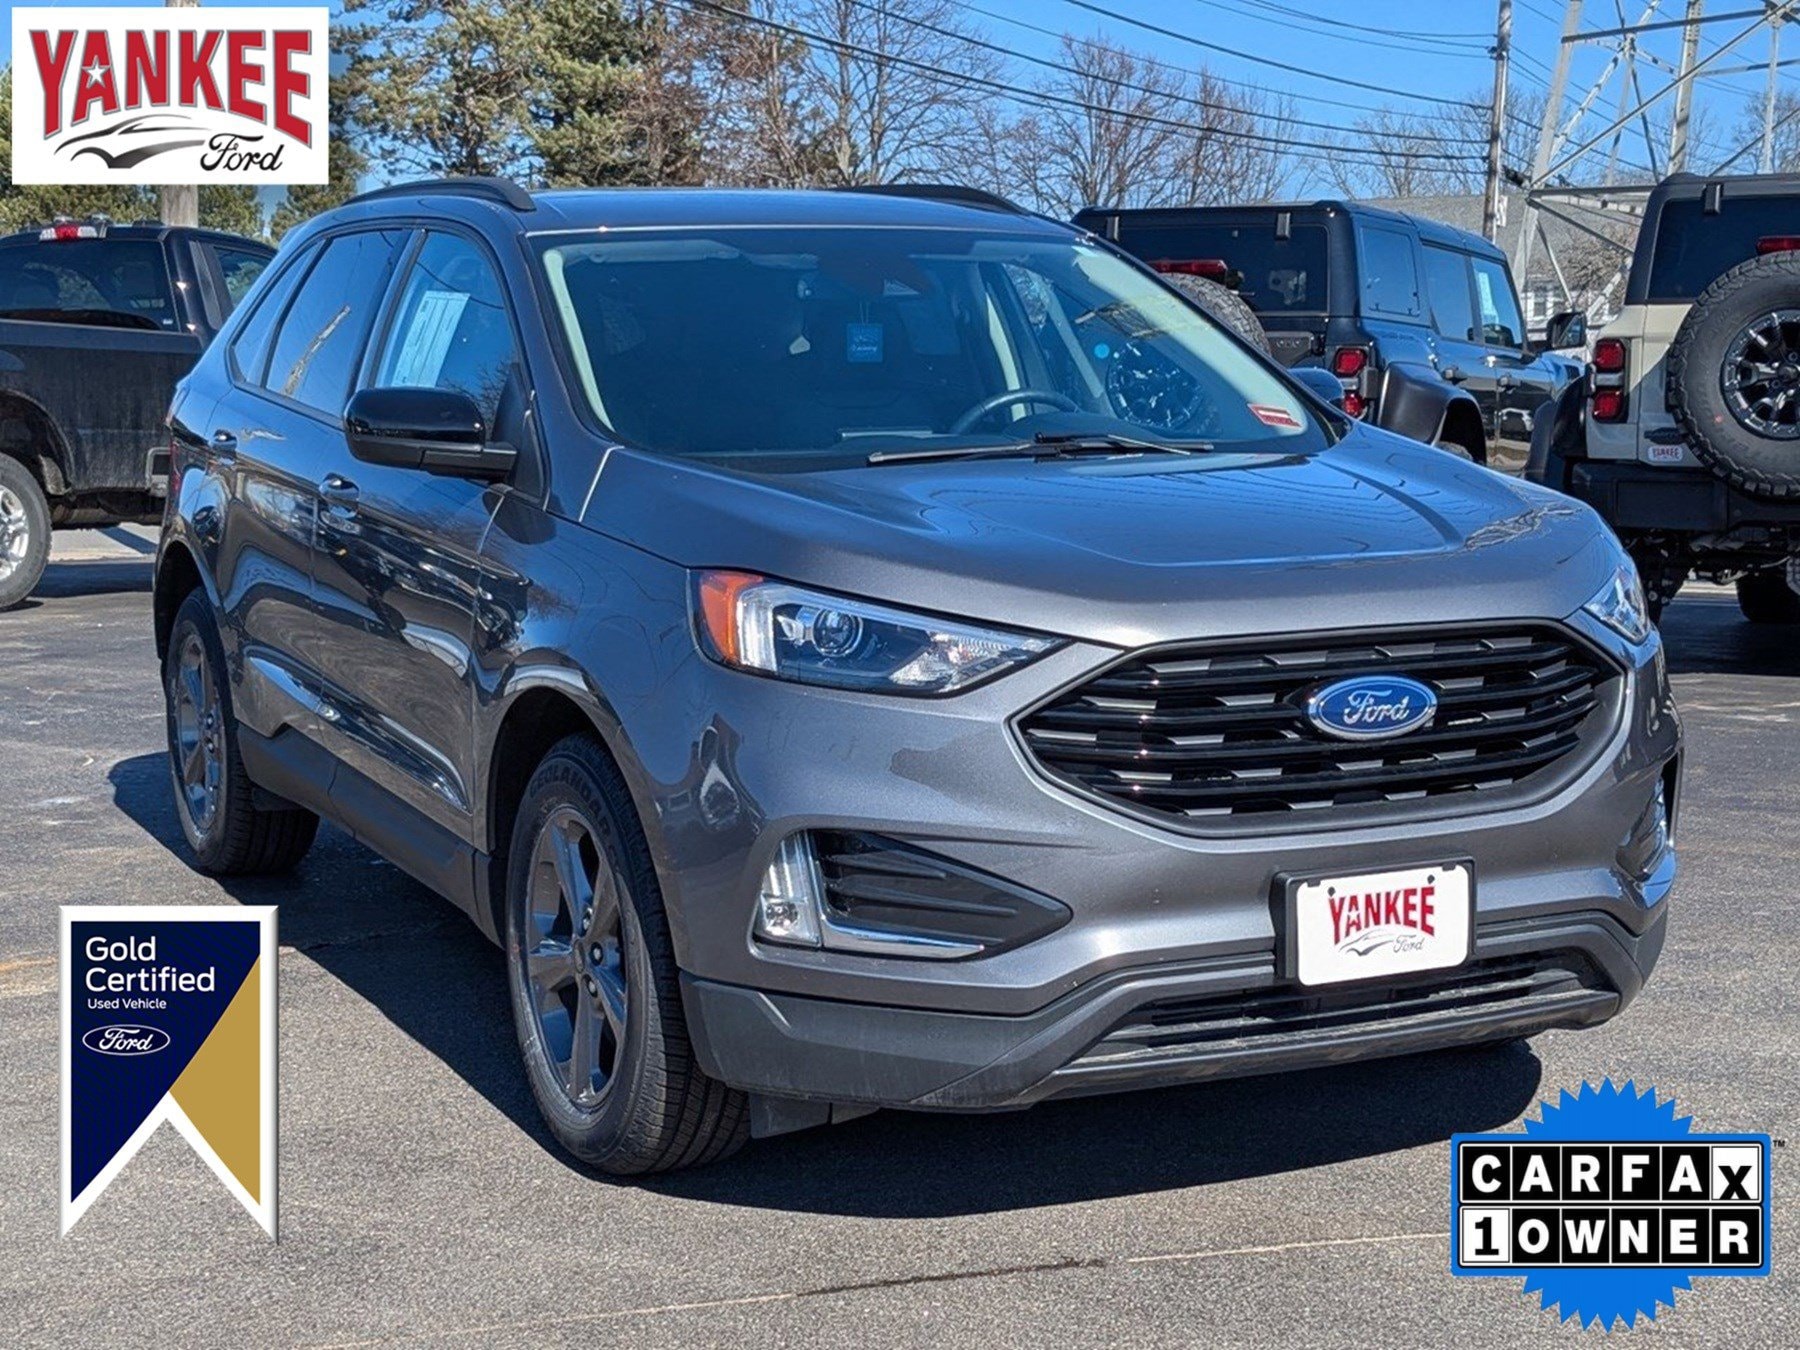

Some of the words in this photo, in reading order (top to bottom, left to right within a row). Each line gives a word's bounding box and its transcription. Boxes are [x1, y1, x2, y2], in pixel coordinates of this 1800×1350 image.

[1343, 689, 1409, 724] Ford
[1328, 886, 1435, 945] YANKEE
[1393, 934, 1424, 953] Ford
